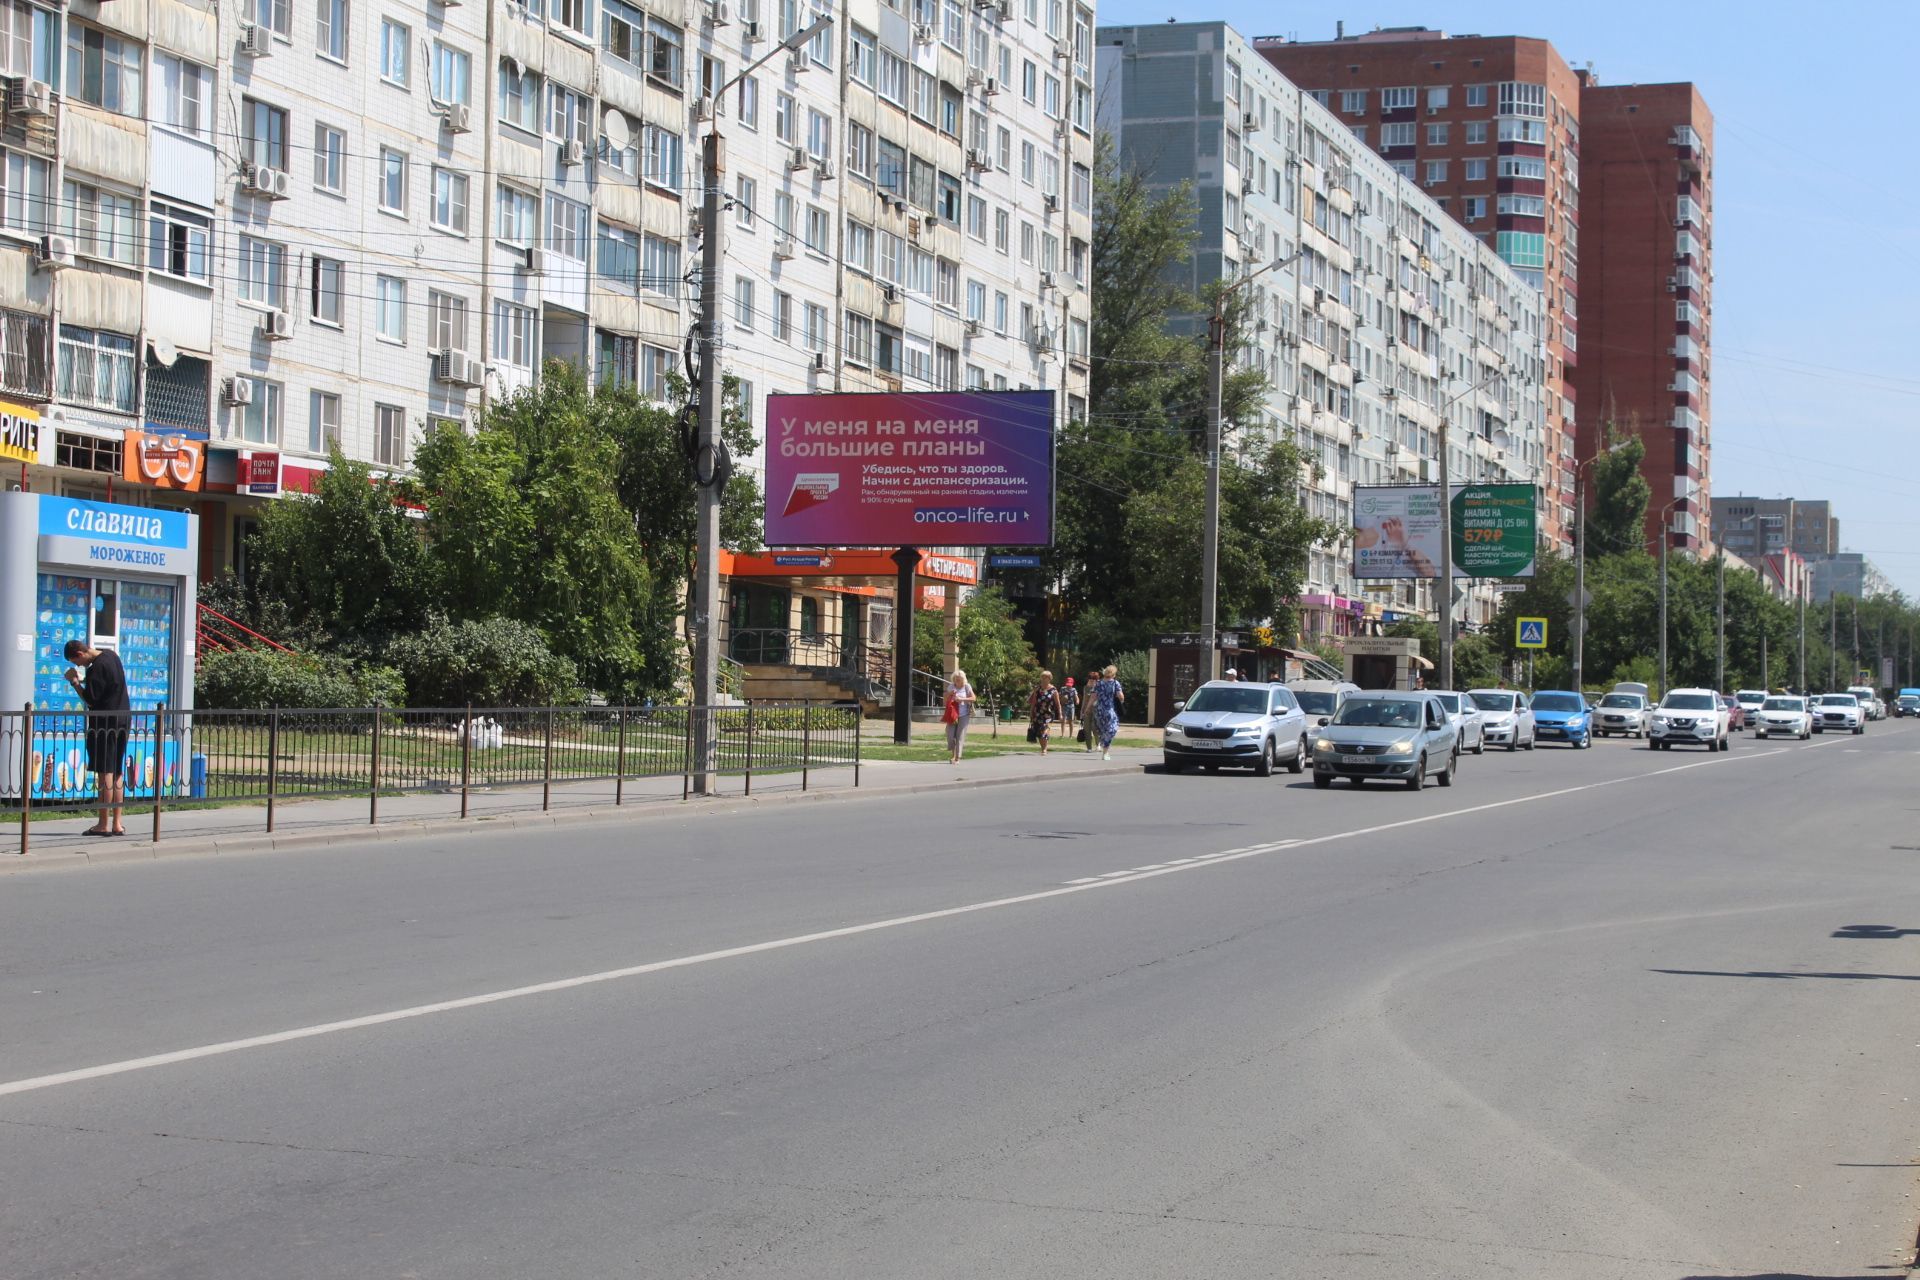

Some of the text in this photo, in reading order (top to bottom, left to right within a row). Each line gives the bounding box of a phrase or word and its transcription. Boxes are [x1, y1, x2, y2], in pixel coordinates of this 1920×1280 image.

[781, 417, 979, 436] У меня на меня
[781, 437, 985, 457] большие планы
[253, 459, 275, 468] ПОЧТА
[253, 467, 272, 475] БАНК
[862, 464, 916, 475] Убедись,
[961, 465, 1008, 475] здоров.
[862, 476, 900, 485] Начни
[913, 476, 1028, 486] диспансеризации.
[876, 488, 930, 496] обнаруженный
[914, 506, 1017, 523] onco-life.ru
[1464, 508, 1501, 517] АНАЛИЗ НА
[1464, 519, 1496, 528] ВИТАМИН
[1496, 519, 1503, 528] Д
[1503, 518, 1514, 528] (25
[90, 545, 166, 566] МОРОЖЕНОЕ
